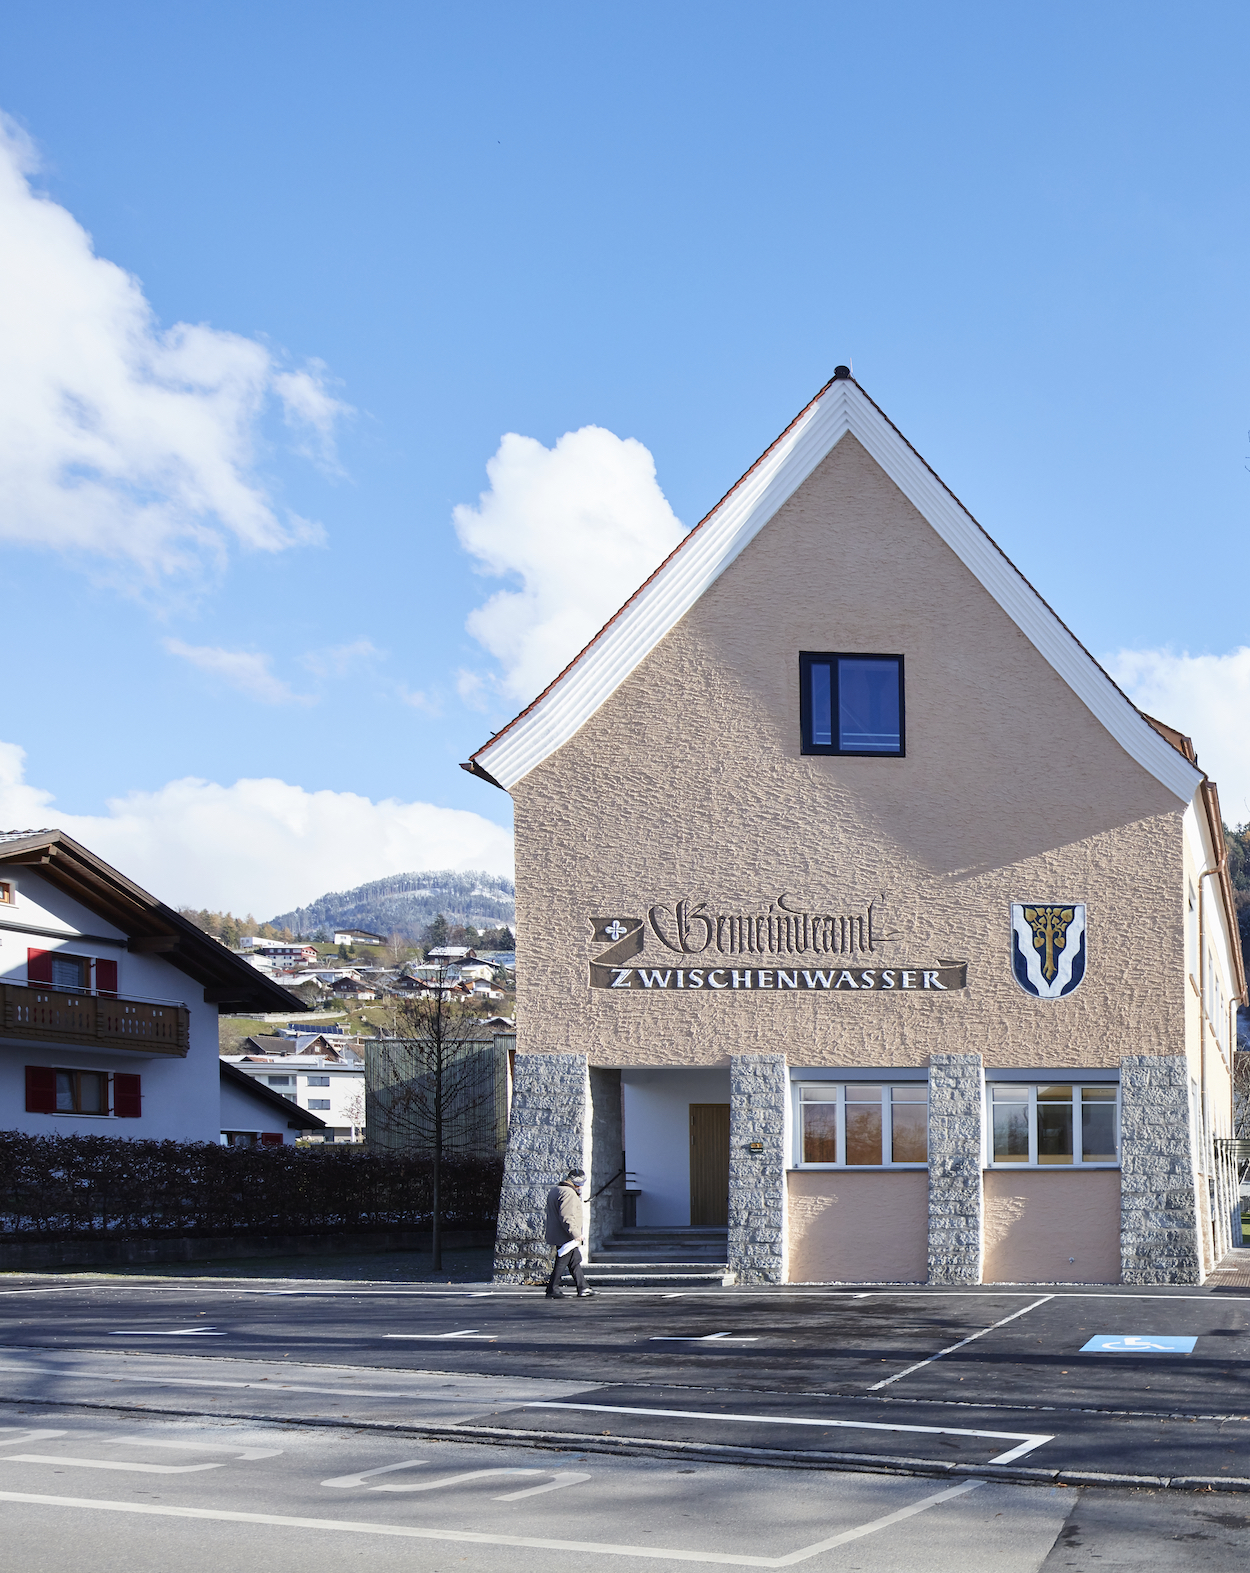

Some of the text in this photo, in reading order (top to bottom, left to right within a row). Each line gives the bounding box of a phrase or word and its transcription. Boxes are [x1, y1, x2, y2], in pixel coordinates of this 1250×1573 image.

[648, 893, 901, 957] Gemeindeamt
[610, 967, 948, 991] ZWISCHENWASSER
[0, 1426, 592, 1502] US
